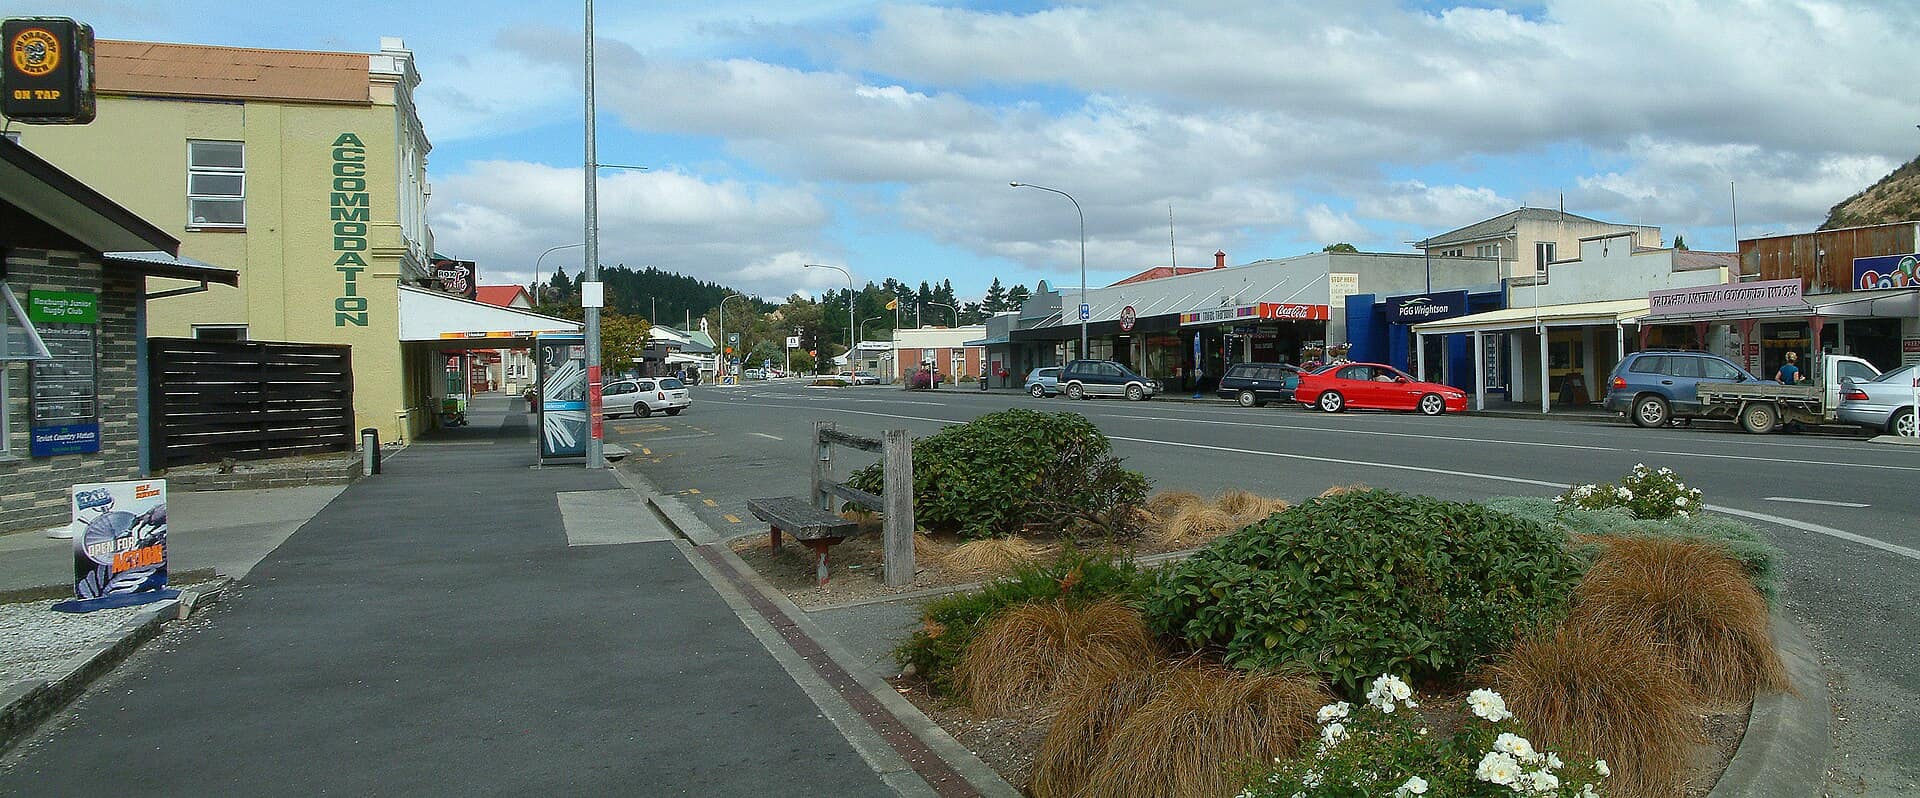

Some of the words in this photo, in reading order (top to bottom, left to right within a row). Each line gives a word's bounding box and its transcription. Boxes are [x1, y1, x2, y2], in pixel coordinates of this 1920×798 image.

[24, 64, 49, 73] BEER
[14, 90, 31, 100] ON
[34, 90, 60, 100] TAP
[331, 133, 370, 327] ACCOMMODATION
[1687, 290, 1722, 305] NATURAL
[1723, 287, 1766, 302] COLOURED
[1767, 284, 1798, 299] WOOLS
[34, 298, 69, 307] Roxburgh
[43, 307, 66, 316] Rugby
[1399, 306, 1414, 316] PGG
[1414, 304, 1449, 317] Wrightson
[81, 491, 107, 503] TAB
[88, 540, 115, 557] OPEN
[117, 537, 135, 551] FOR
[112, 543, 164, 574] ACTION
